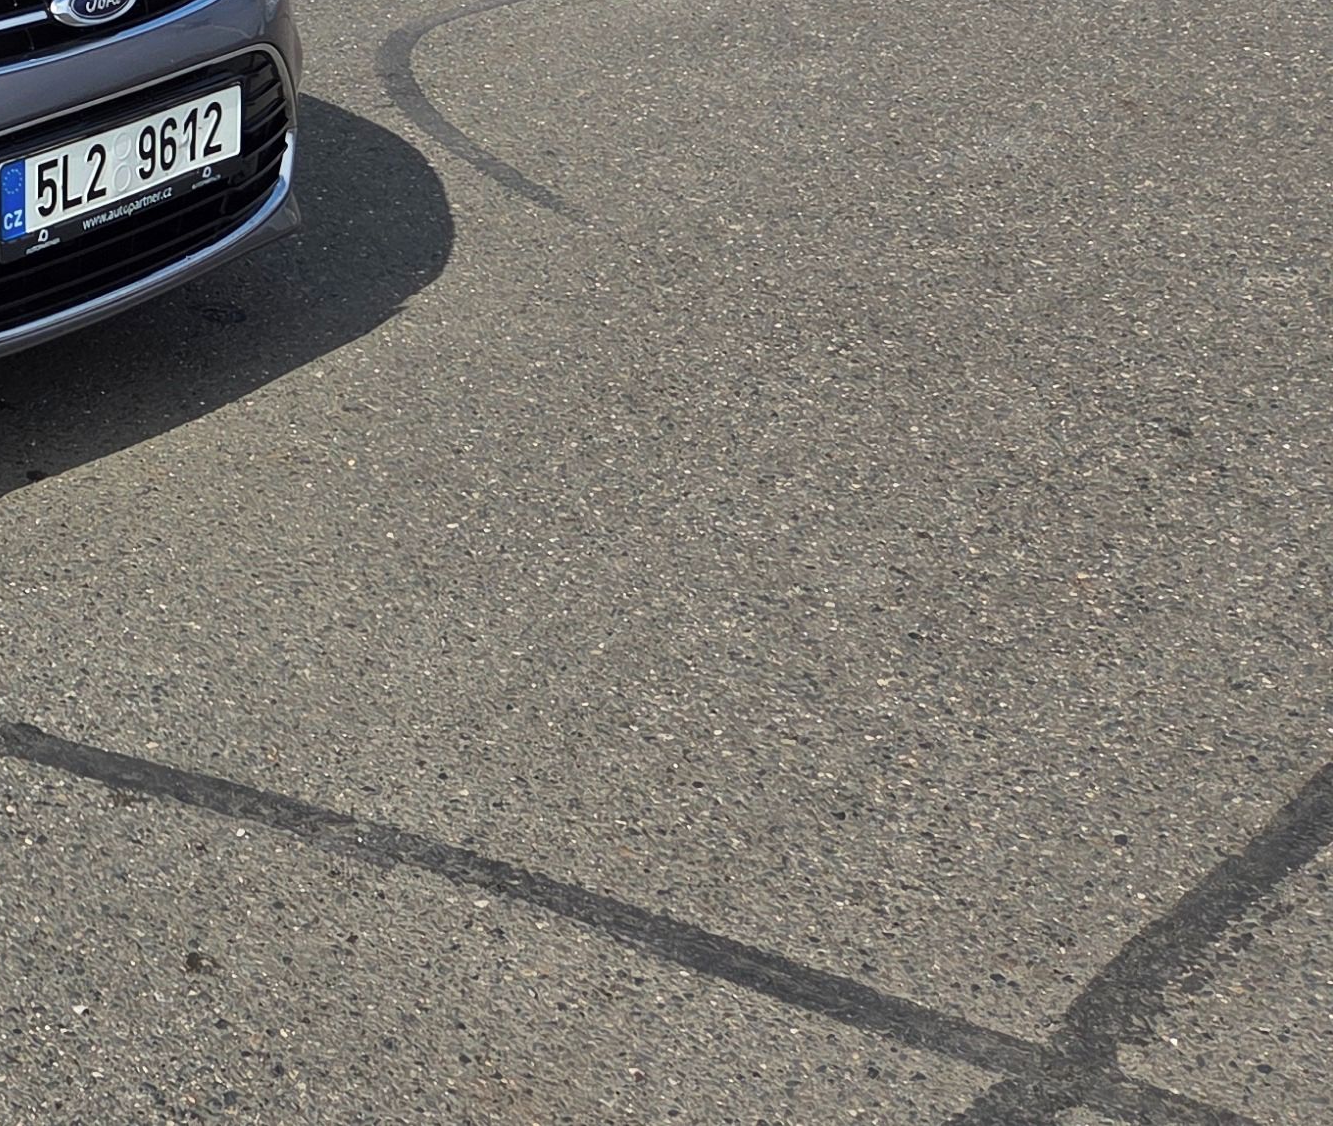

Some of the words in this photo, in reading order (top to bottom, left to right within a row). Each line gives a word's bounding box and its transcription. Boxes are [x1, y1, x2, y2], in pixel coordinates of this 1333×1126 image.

[37, 143, 107, 218] 5L2
[137, 101, 223, 180] 9612
[3, 210, 23, 230] CZ
[82, 186, 173, 231] www.autopartner.cz
